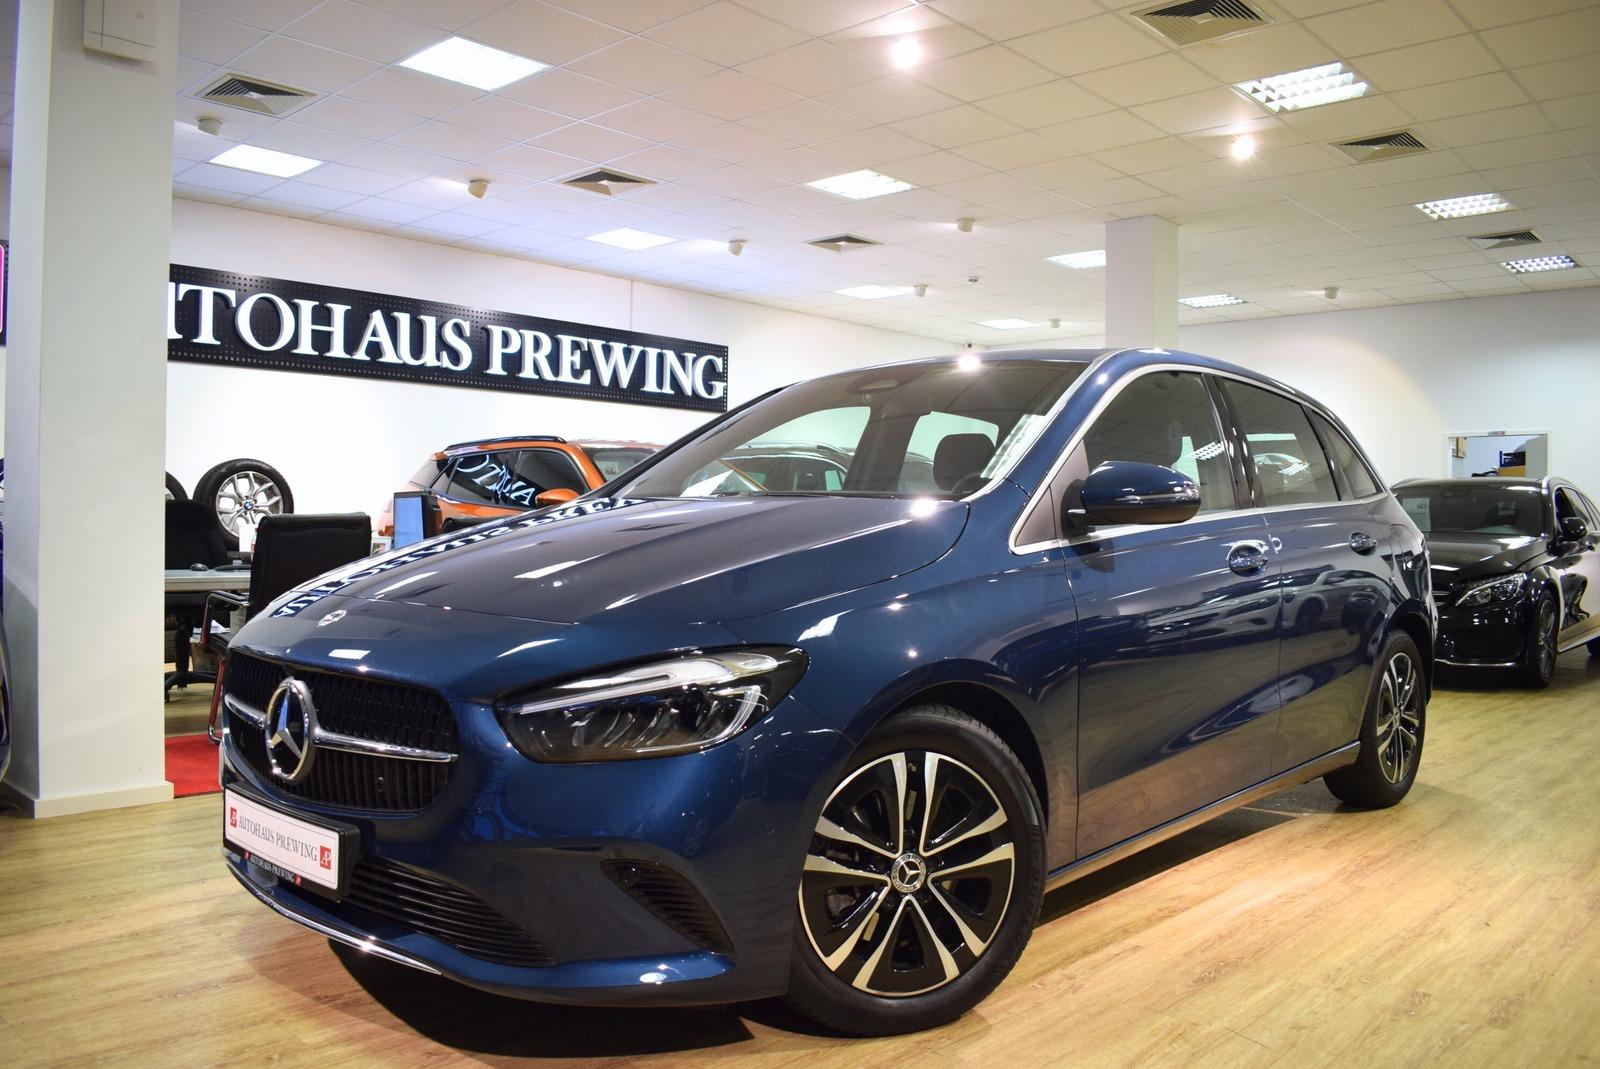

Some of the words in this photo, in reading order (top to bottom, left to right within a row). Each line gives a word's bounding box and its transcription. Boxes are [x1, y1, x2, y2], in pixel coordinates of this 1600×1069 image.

[484, 324, 727, 399] PREWING
[239, 816, 275, 844] AUTOHAUS
[276, 832, 317, 861] PREWING
